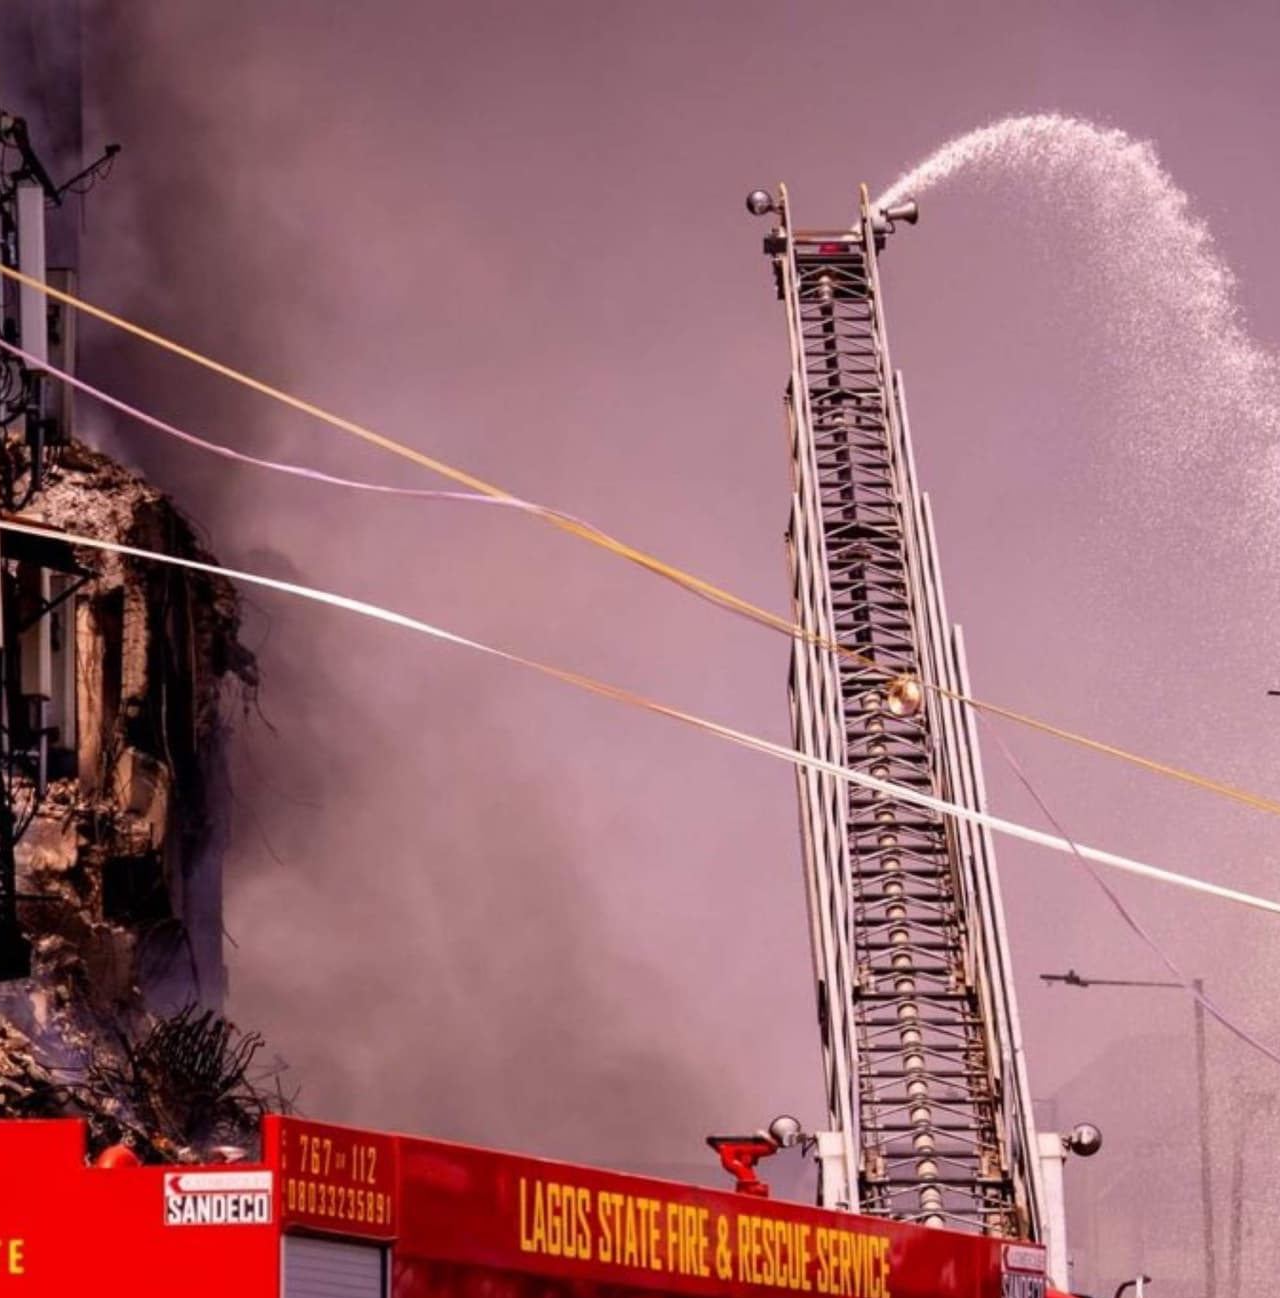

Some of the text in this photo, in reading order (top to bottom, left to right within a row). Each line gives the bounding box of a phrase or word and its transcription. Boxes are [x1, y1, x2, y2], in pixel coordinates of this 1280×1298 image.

[300, 1133, 332, 1176] 767
[352, 1144, 377, 1185] 112
[167, 1193, 270, 1225] SANDECO
[288, 1178, 392, 1226] 08033235891
[520, 1177, 591, 1260] LAGOS
[598, 1191, 662, 1270] STATE
[667, 1202, 710, 1277] FIRE
[716, 1215, 733, 1281] &
[737, 1214, 812, 1291] RESCUE
